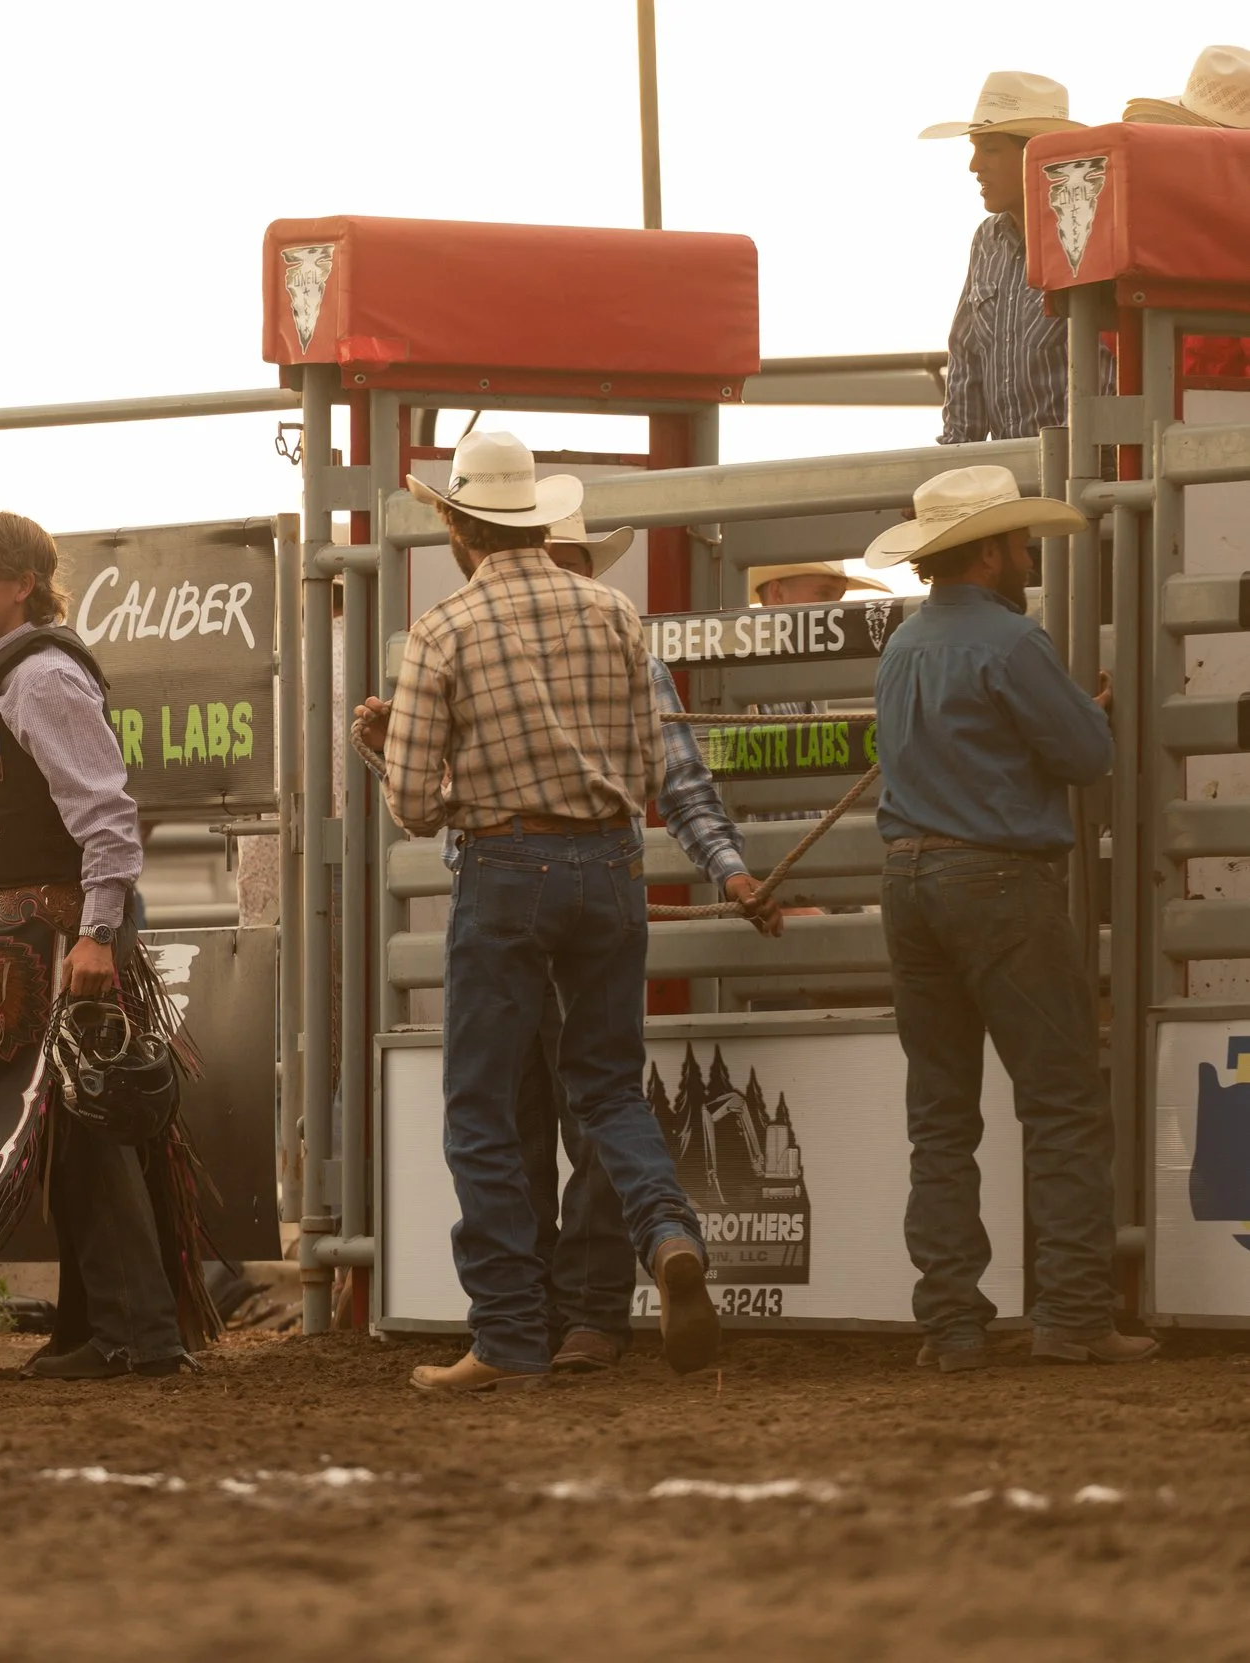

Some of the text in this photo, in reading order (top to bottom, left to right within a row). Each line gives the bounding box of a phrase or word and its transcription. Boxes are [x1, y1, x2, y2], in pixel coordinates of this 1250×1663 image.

[76, 566, 255, 649] CALIBER
[734, 608, 845, 658] SERIES
[161, 701, 254, 769] LABS
[796, 721, 849, 769] LABS
[697, 1212, 804, 1242] BROTHERS
[740, 1250, 768, 1262] LLC
